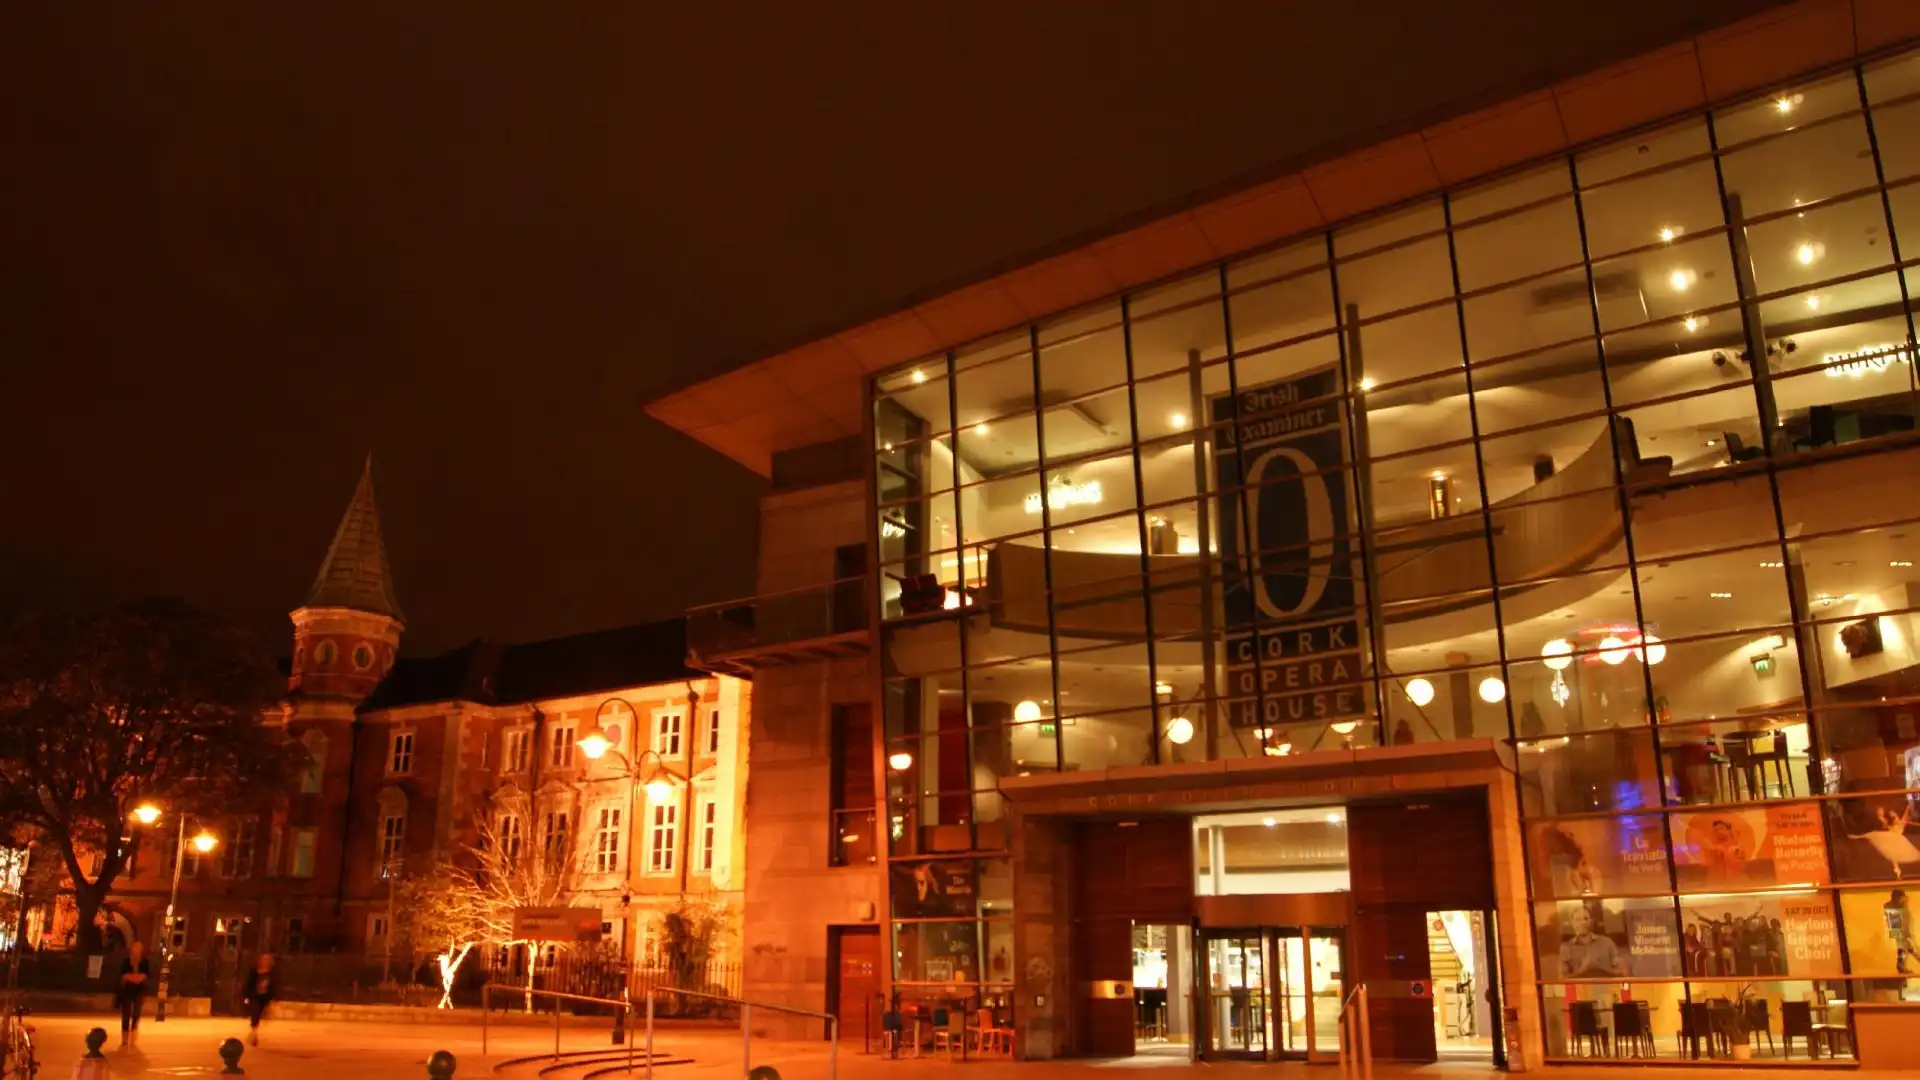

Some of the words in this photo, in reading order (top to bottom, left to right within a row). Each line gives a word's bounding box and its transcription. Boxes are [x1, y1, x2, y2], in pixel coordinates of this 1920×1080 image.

[1244, 384, 1299, 412] Irish
[1226, 408, 1326, 444] Examiner
[1238, 627, 1346, 661] CORK
[1240, 659, 1349, 694] OPERA
[1242, 691, 1353, 724] HOUSE
[1794, 945, 1832, 960] Choir
